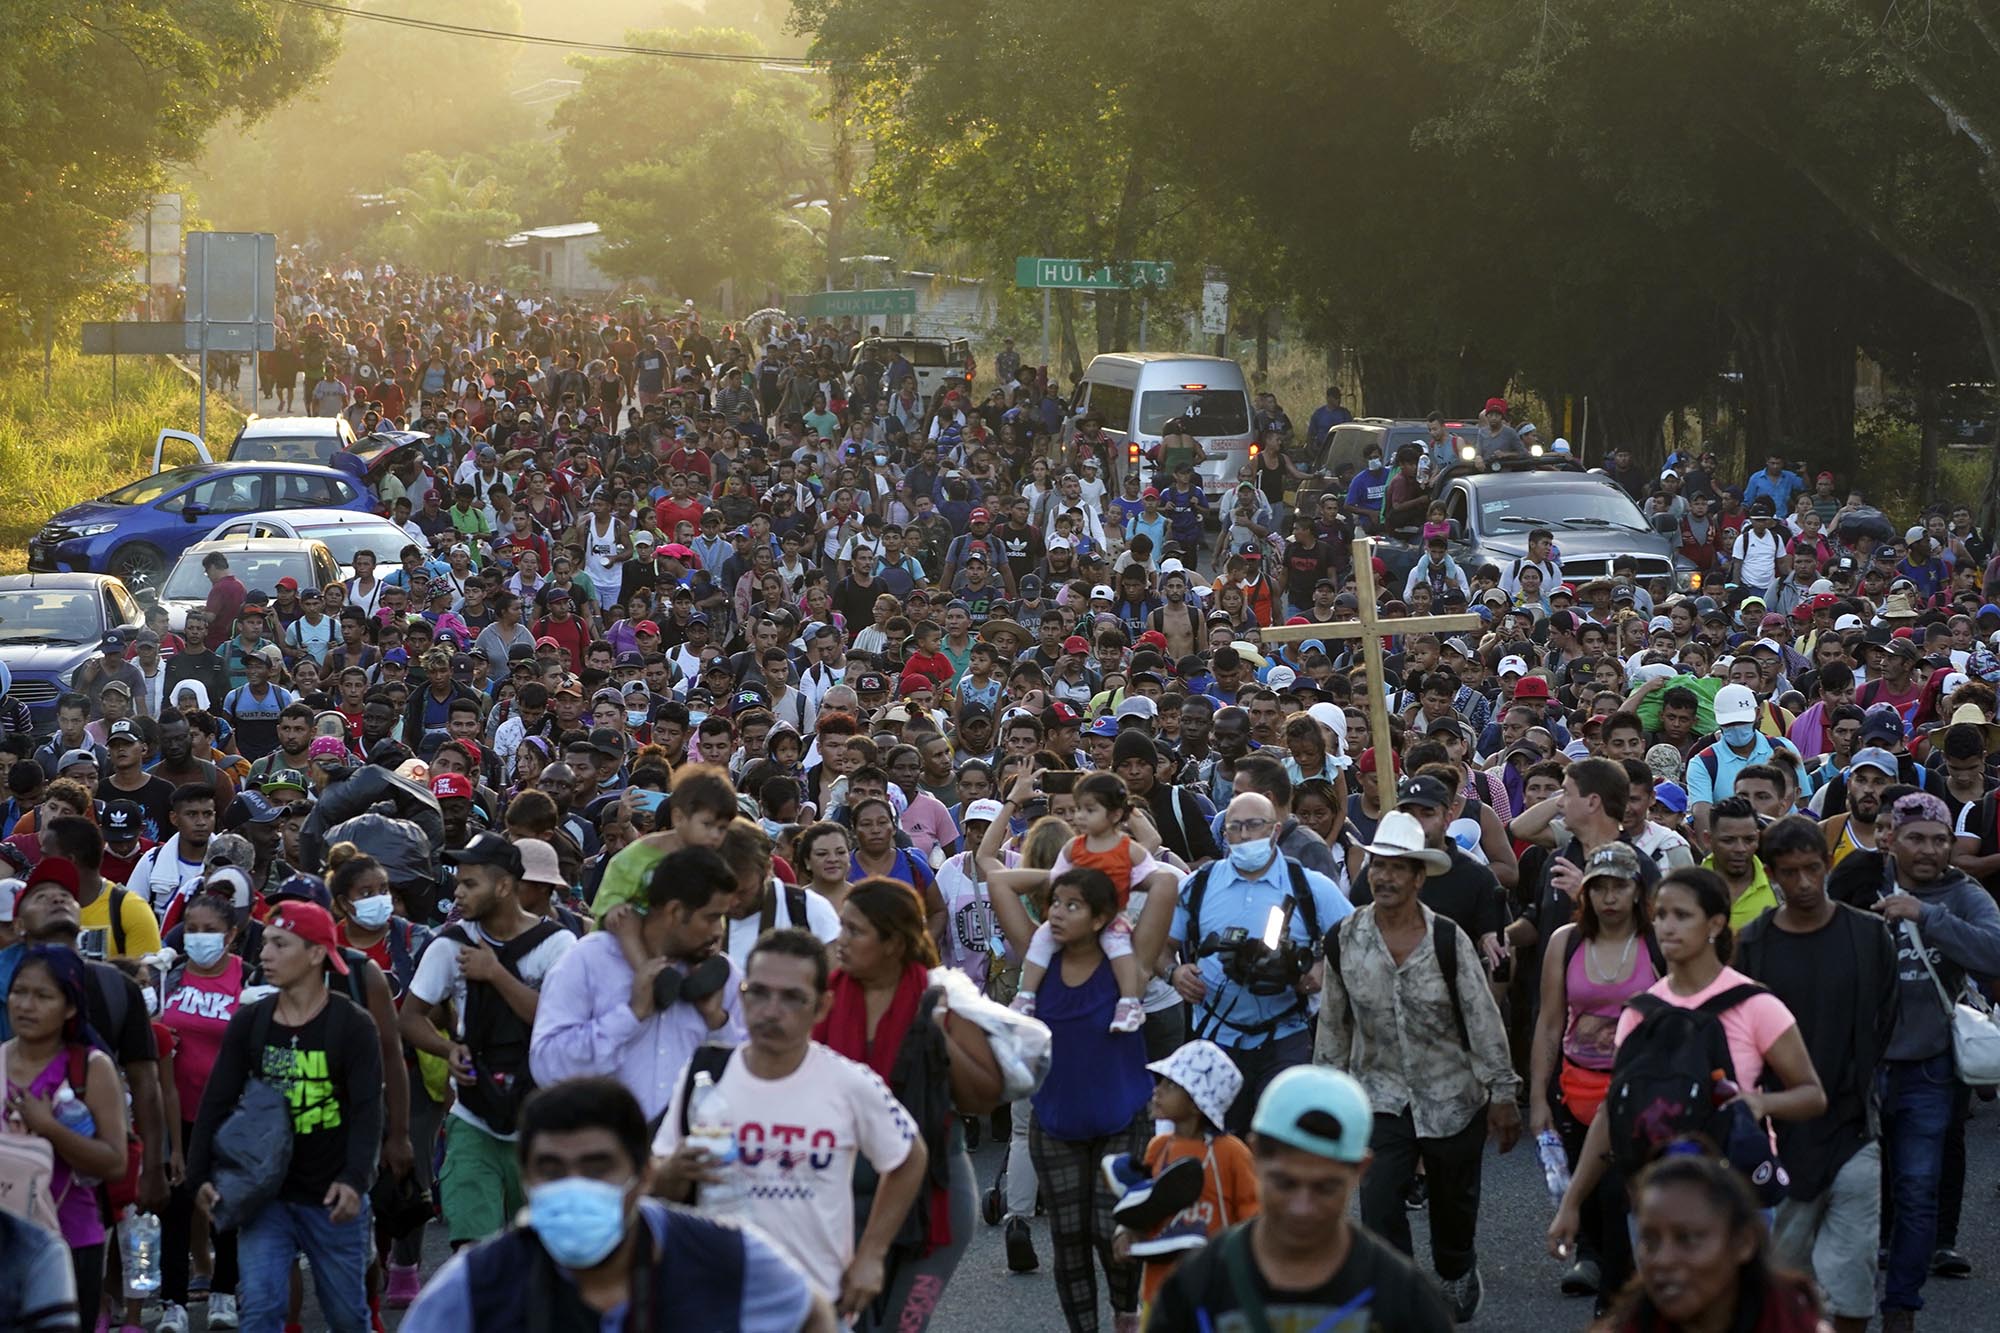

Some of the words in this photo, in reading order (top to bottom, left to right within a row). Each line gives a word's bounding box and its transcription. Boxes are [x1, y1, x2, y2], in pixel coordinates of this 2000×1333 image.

[1155, 267, 1167, 284] 3
[826, 298, 895, 312] HUIXTLA
[900, 296, 910, 310] 3
[164, 985, 235, 1021] PINK
